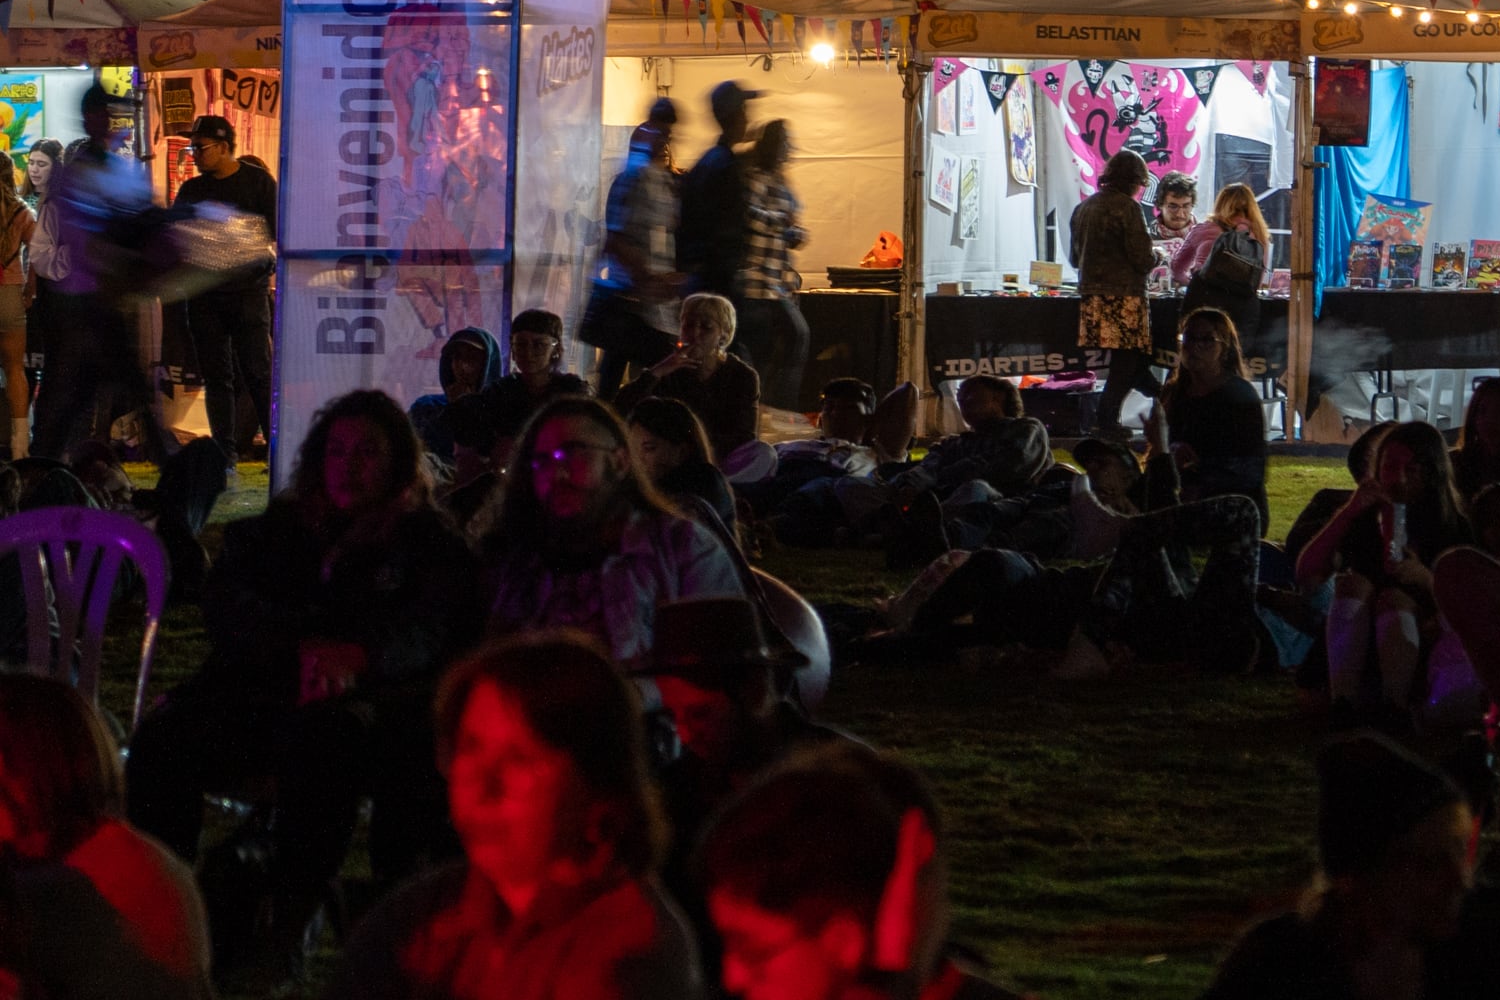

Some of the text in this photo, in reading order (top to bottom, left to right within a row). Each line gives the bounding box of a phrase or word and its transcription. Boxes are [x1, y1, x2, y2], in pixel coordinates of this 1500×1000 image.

[1036, 25, 1141, 41] BELASTTIAN
[1414, 23, 1441, 37] GO
[1444, 22, 1468, 37] UP
[945, 353, 1065, 376] IDARTES
